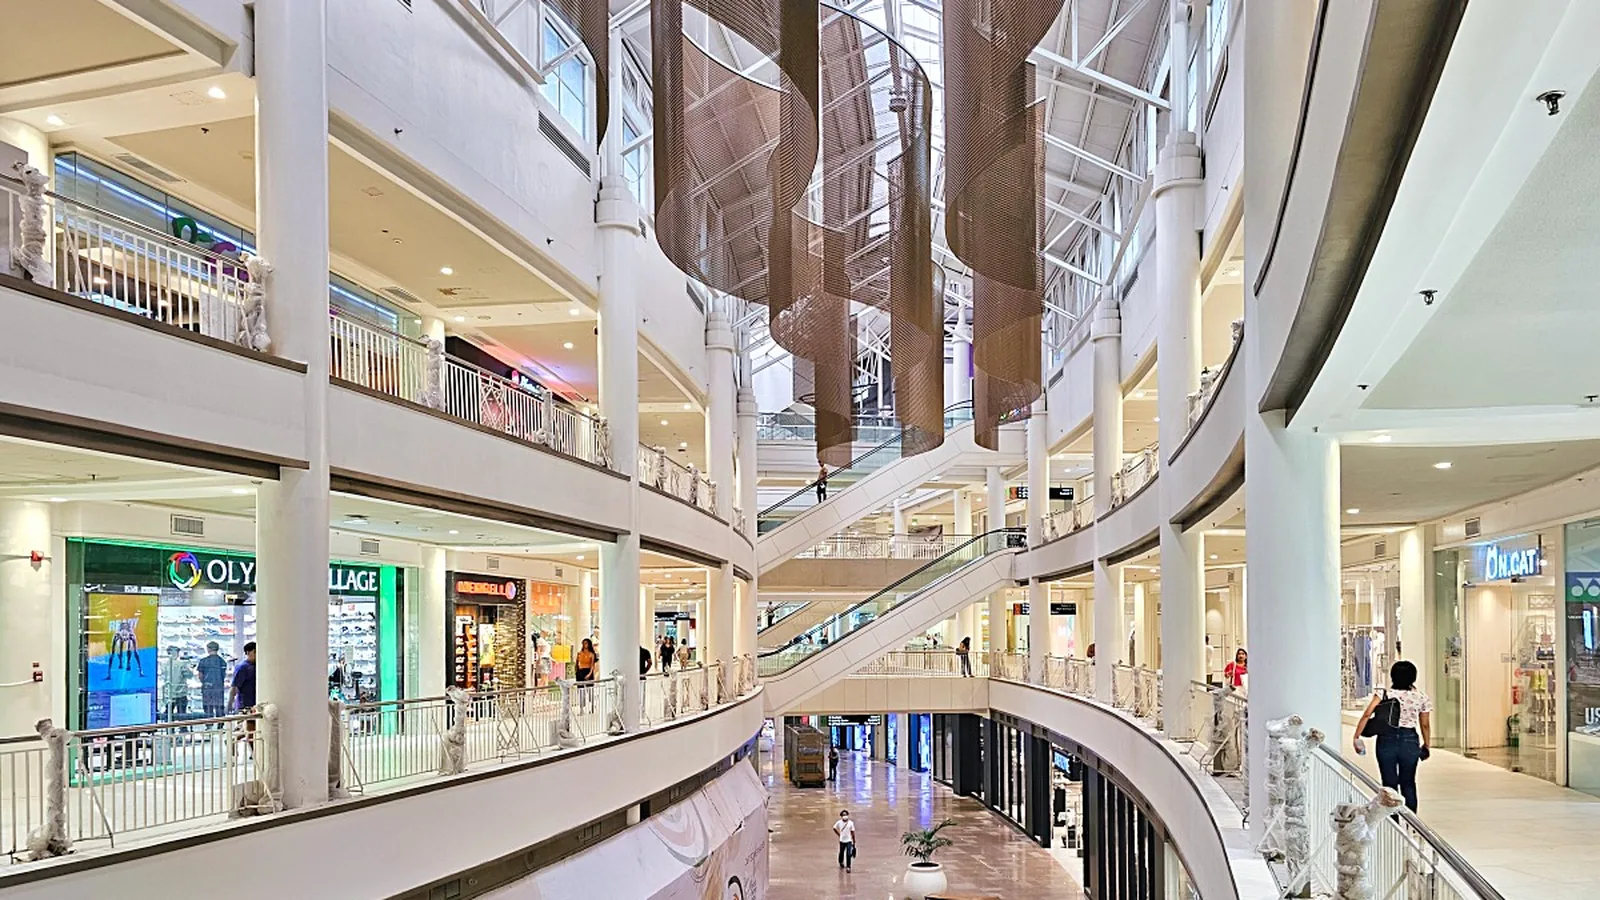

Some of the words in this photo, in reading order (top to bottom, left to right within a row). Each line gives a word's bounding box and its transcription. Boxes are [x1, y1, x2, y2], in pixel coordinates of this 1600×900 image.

[206, 559, 256, 584] OLY
[328, 568, 378, 592] LLAGE
[109, 617, 139, 632] REDY
